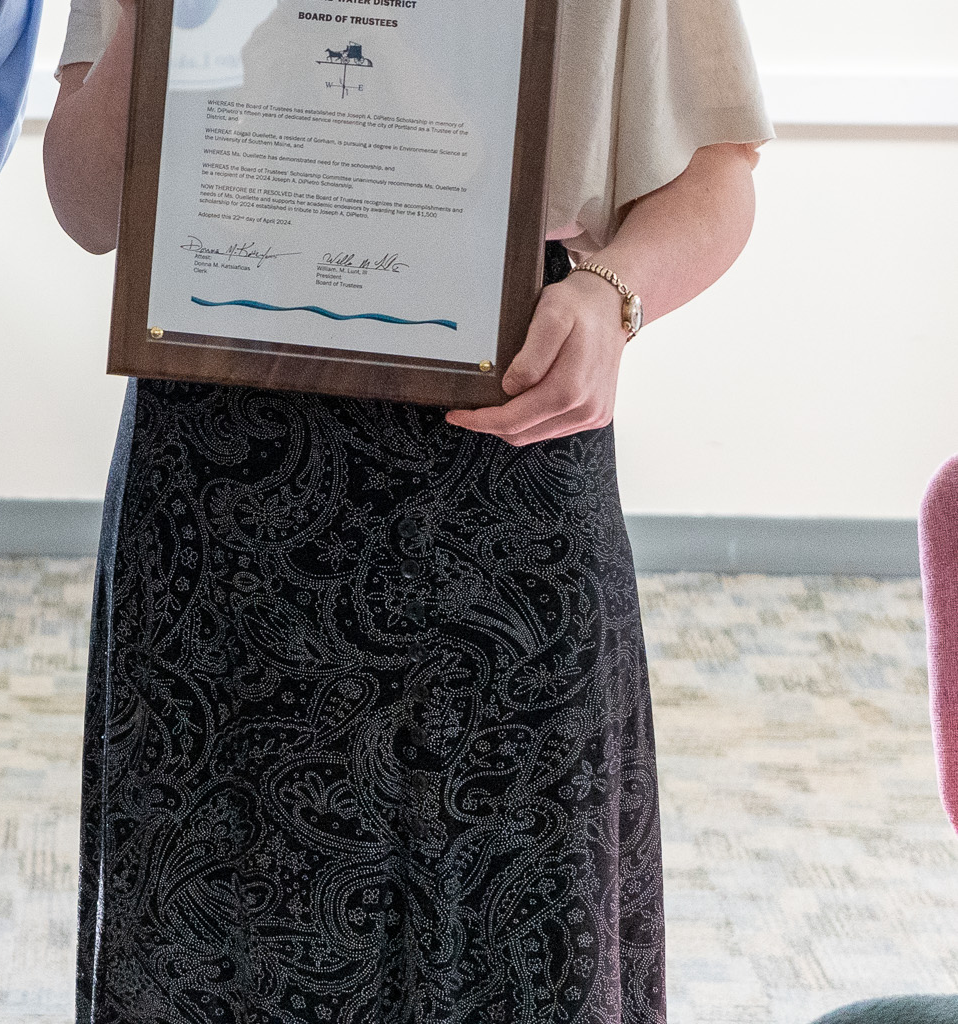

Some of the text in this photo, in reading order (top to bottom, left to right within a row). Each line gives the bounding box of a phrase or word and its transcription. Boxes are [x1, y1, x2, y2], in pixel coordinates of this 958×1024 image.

[298, 12, 398, 27] BOARD OF TRUSTEES
[332, 118, 366, 126] representing
[396, 117, 427, 125] Scholarship
[399, 145, 437, 153] Environmental
[278, 155, 316, 163] demonstrated
[351, 162, 383, 170] scholarship,
[290, 170, 320, 179] Scholarship
[352, 176, 386, 185] unanimously
[199, 198, 229, 206] scholarship
[364, 199, 392, 207] recognizes
[403, 202, 450, 212] accomplishments
